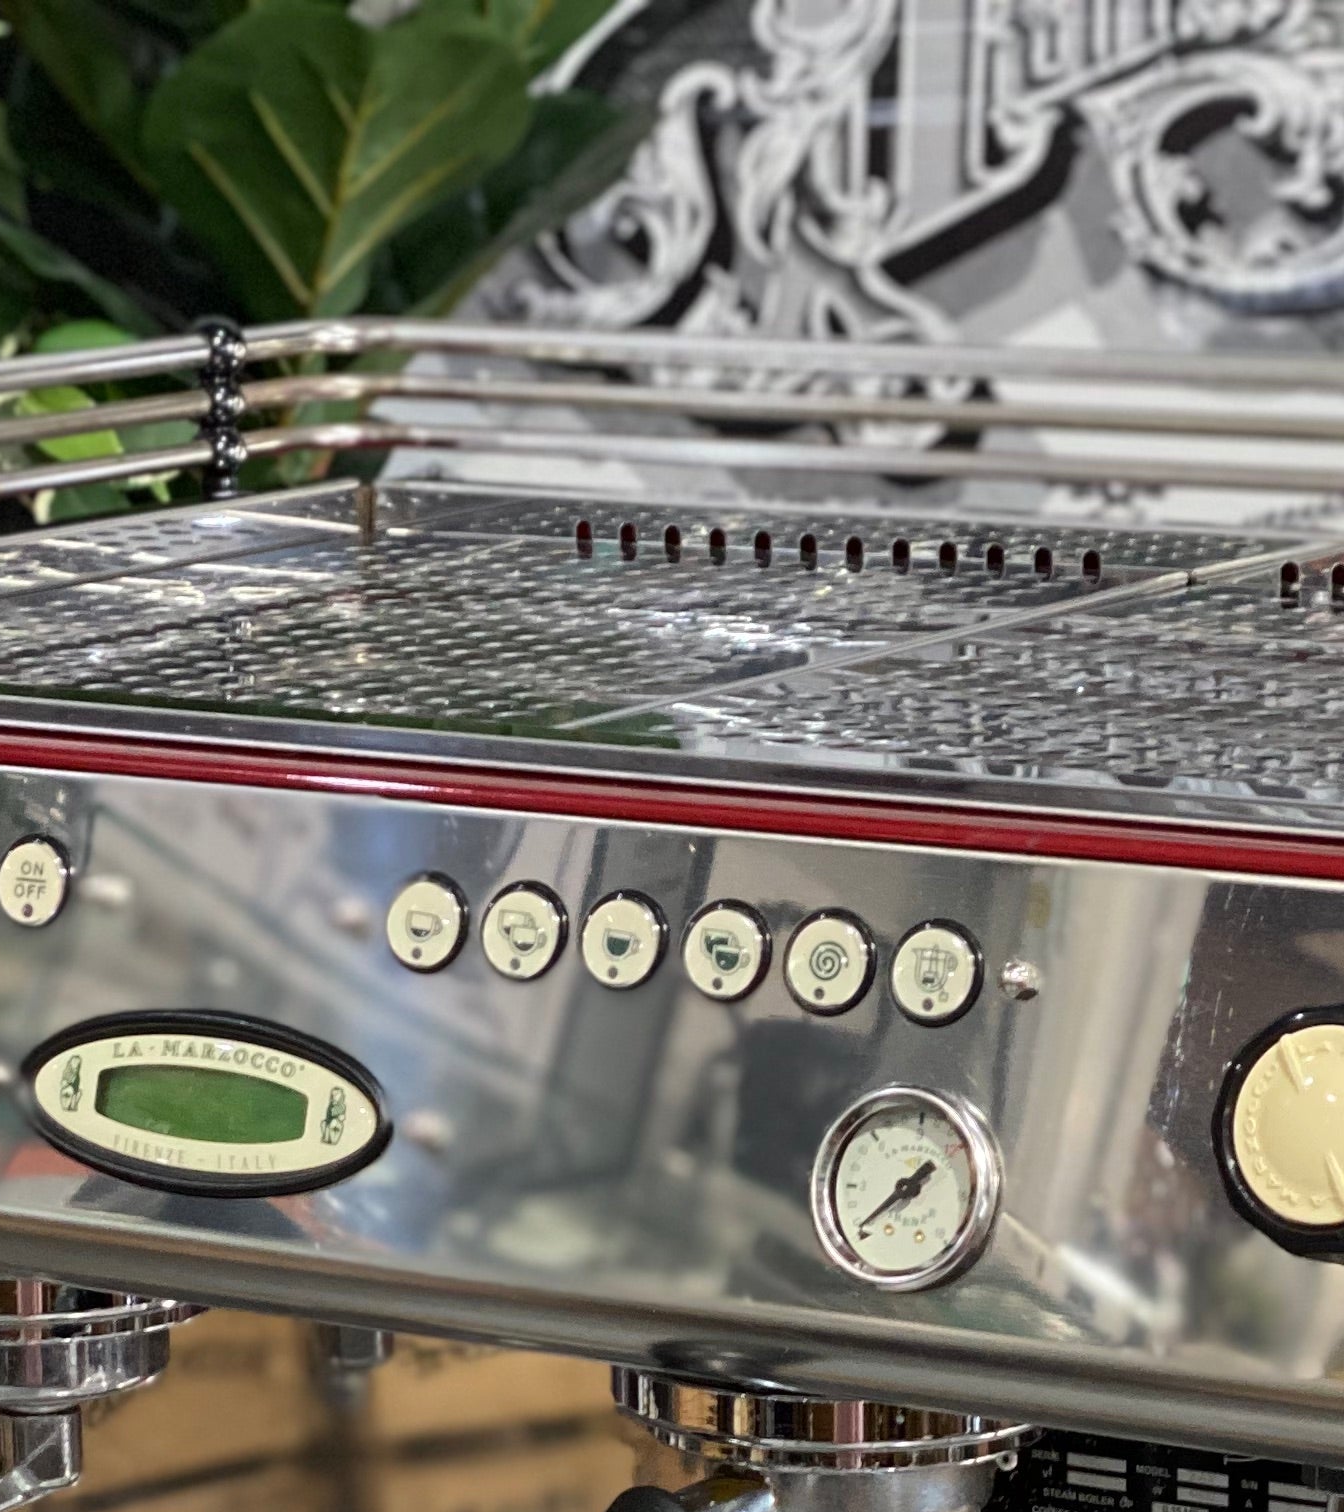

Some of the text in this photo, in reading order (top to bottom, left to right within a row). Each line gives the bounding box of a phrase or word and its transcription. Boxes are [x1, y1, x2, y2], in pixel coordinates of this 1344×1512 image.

[20, 860, 45, 876] ON
[14, 882, 47, 900] OFF
[112, 1039, 297, 1079] LA MARZOCCO
[113, 1134, 277, 1171] FIRENZE ITALY
[1043, 1487, 1077, 1501] STEAM
[1078, 1493, 1115, 1507] BOILER
